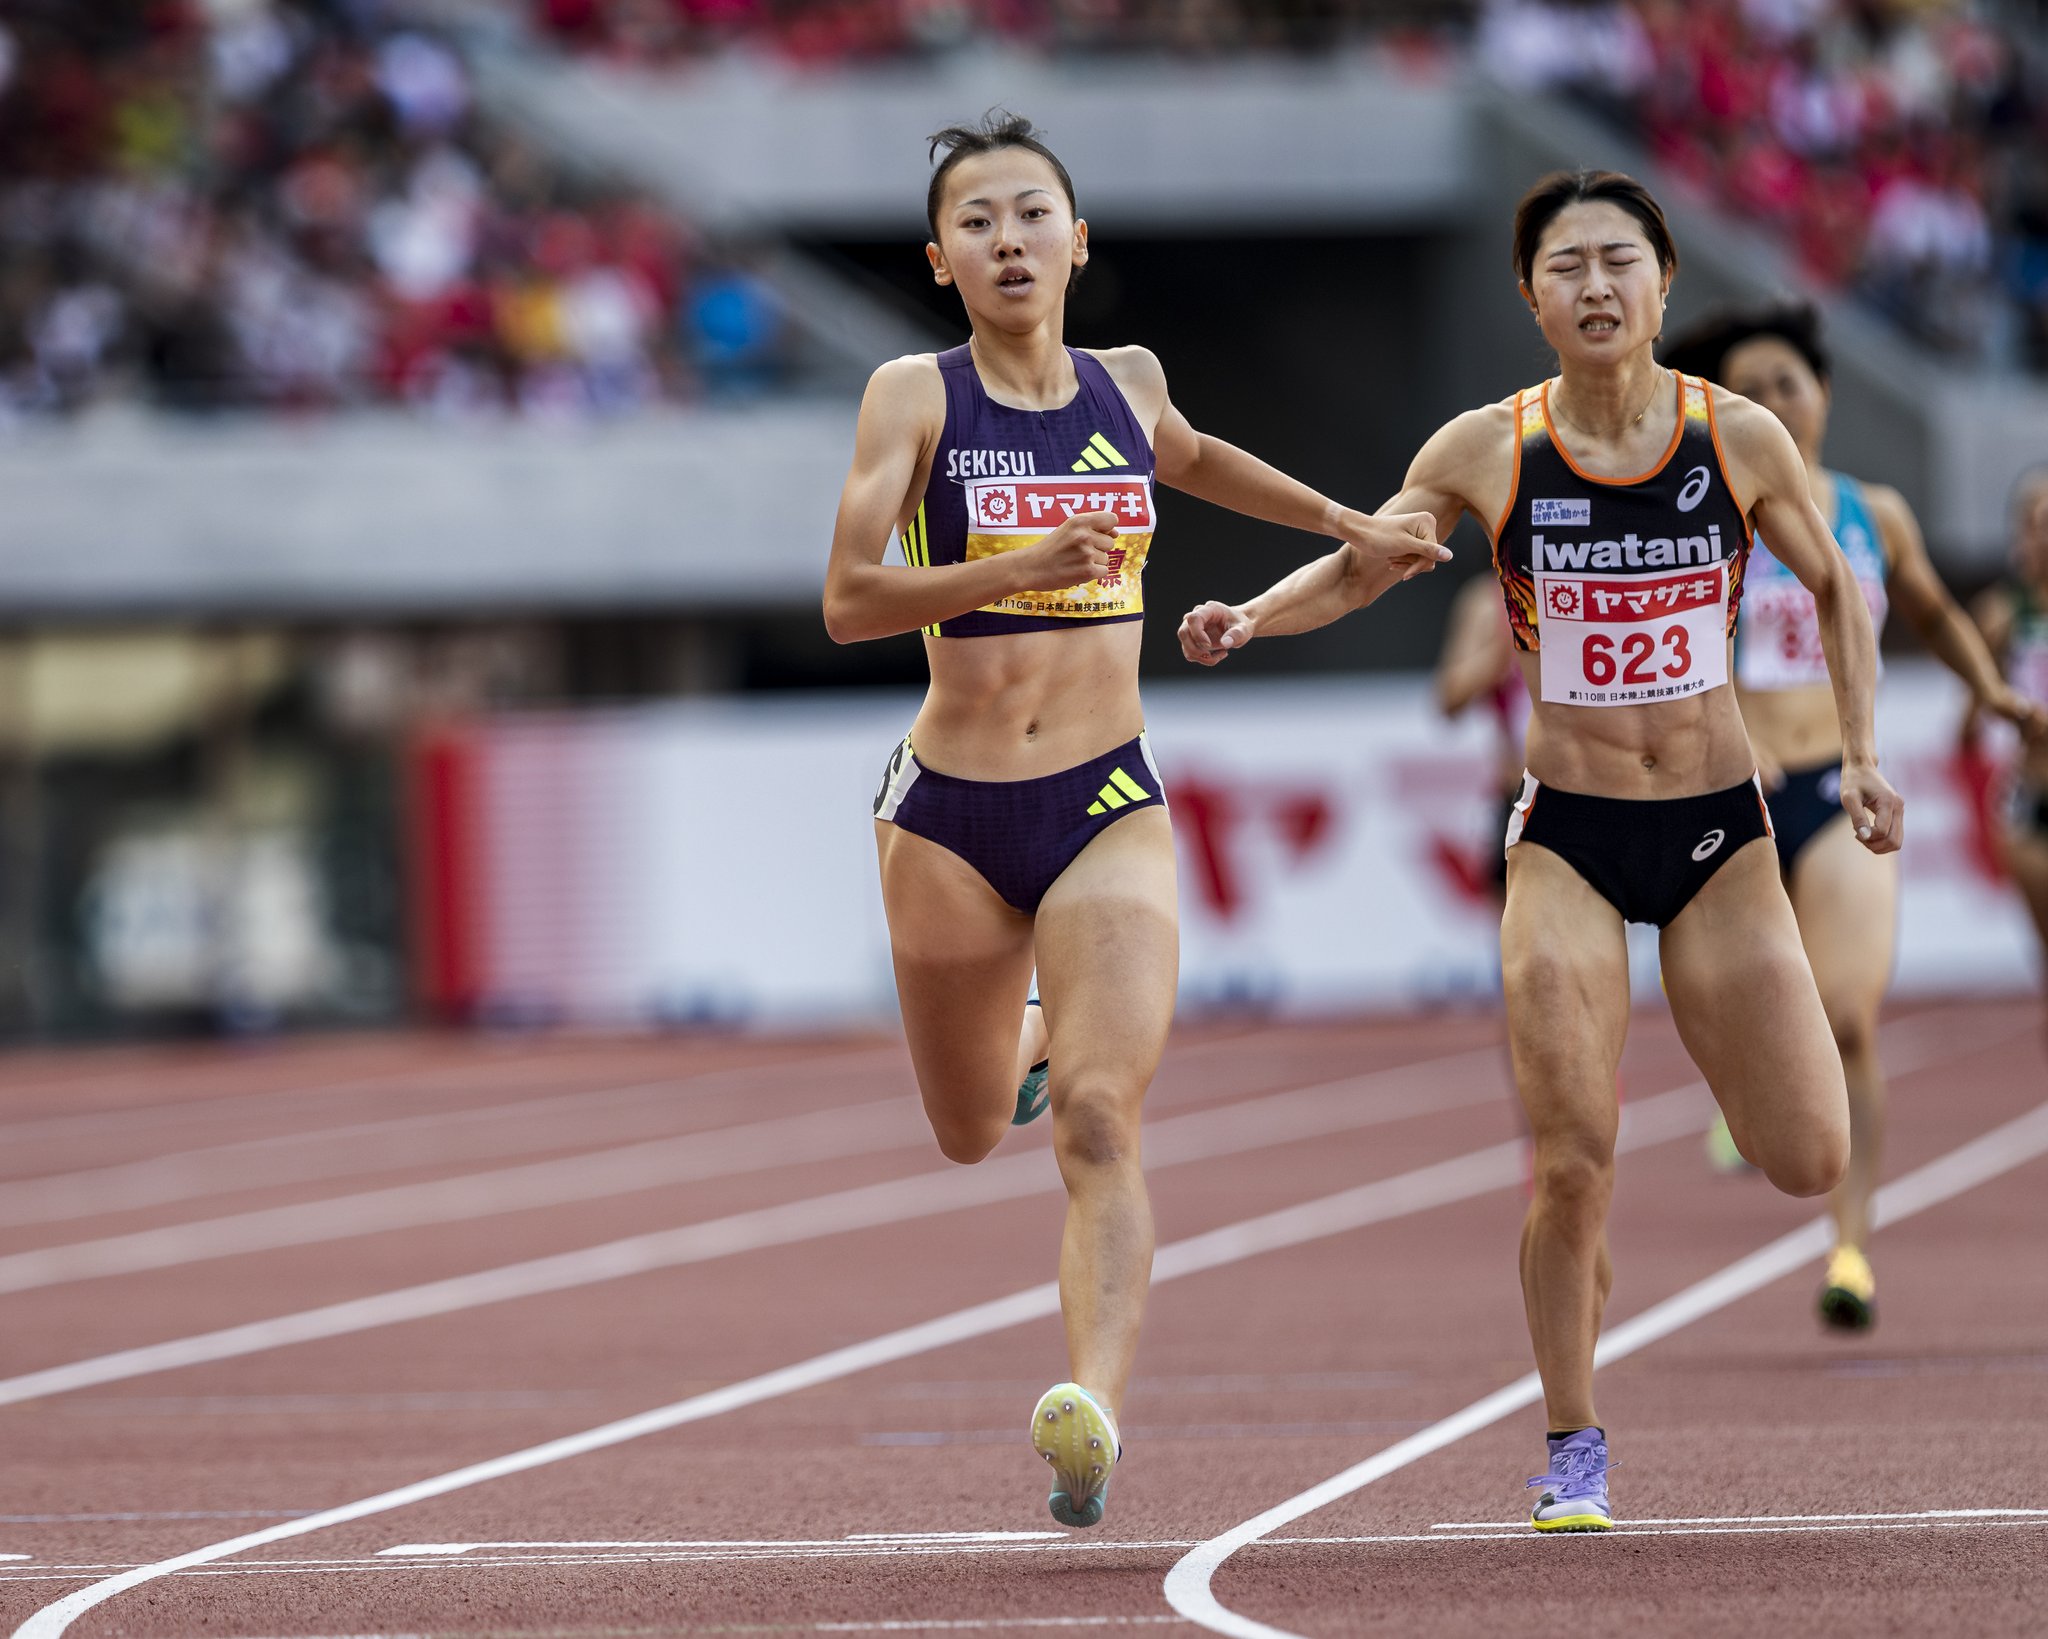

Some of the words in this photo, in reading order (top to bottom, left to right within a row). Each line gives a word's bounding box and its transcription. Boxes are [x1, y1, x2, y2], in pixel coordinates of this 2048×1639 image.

[946, 449, 1036, 477] SEKISUI
[1025, 492, 1143, 518] ヤマザキ
[1532, 524, 1722, 571] Iwatani
[1592, 579, 1715, 615] ヤマザキ
[1582, 625, 1692, 686] 623
[1569, 690, 1606, 702] 第110回
